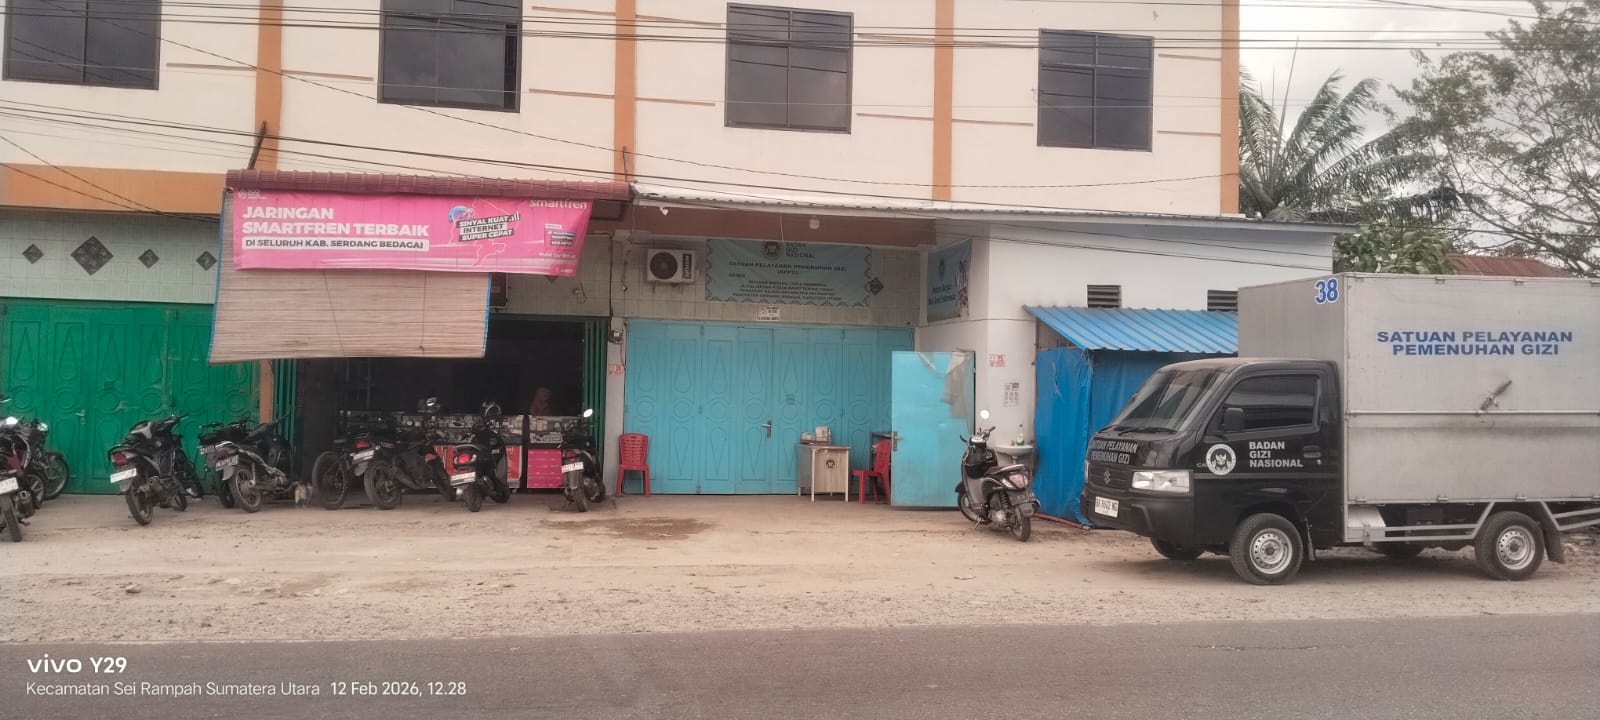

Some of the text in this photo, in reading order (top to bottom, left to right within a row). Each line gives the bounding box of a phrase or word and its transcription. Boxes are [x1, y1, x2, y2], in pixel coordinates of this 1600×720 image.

[242, 206, 334, 220] JARINGAN
[459, 216, 508, 227] SINYAL KUAT
[242, 222, 430, 237] SMARTFREN TERBAIK
[463, 223, 503, 234] INTERNET
[462, 229, 512, 241] SUPER CEPAT
[257, 239, 303, 248] SELURUH
[305, 240, 328, 248] KAB.
[330, 240, 377, 249] SERDANG
[379, 241, 424, 249] BEDAGAI
[1314, 279, 1339, 304] 38
[1377, 331, 1573, 343] SATUAN PELAYANAN
[1392, 344, 1559, 356] PEMENUHAN GIZI
[1106, 441, 1139, 454] PELAYANAN
[1248, 441, 1285, 450] BADAN
[1118, 453, 1130, 464] GIZI
[1249, 450, 1271, 459] GIZI
[1249, 459, 1304, 468] NASIONAL
